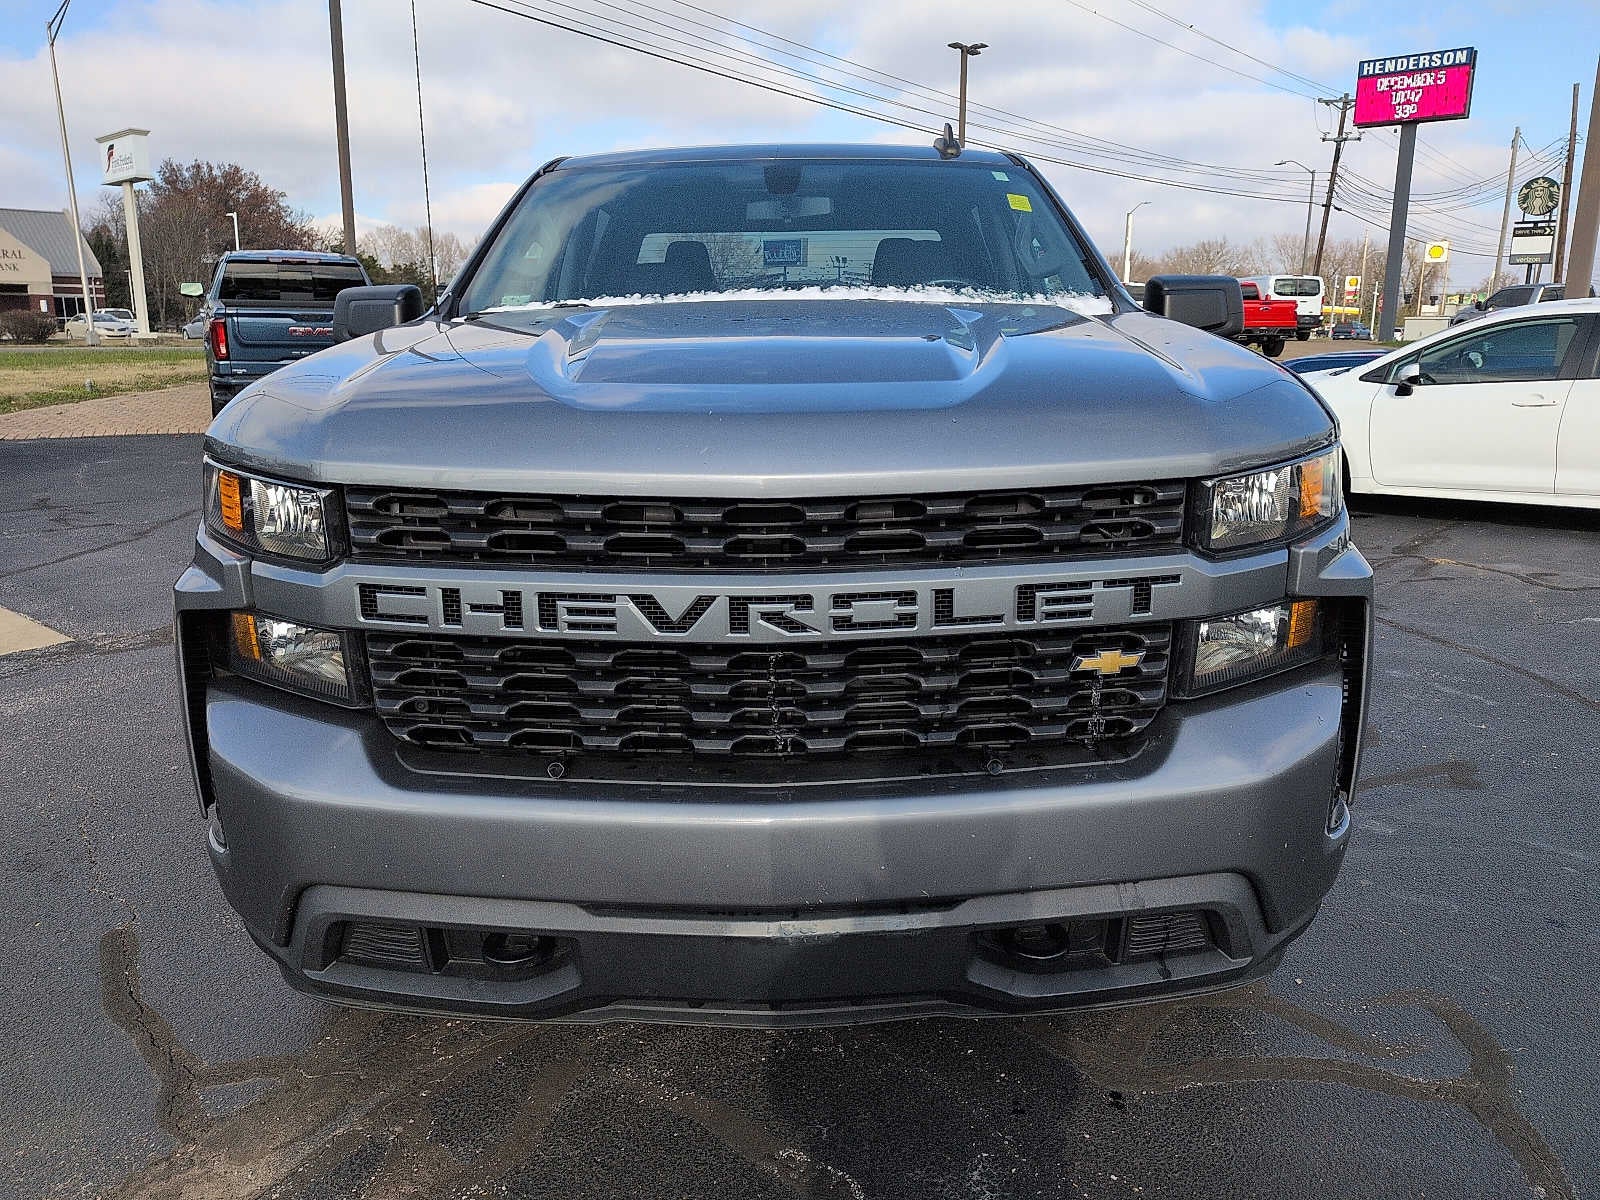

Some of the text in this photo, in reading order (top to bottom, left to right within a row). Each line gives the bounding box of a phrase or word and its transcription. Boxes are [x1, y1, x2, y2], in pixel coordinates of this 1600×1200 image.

[1363, 50, 1467, 75] HENDERSON
[1377, 73, 1435, 91] DECEMBER
[0, 249, 26, 259] RAL
[356, 574, 1184, 637] CHEVROLET
